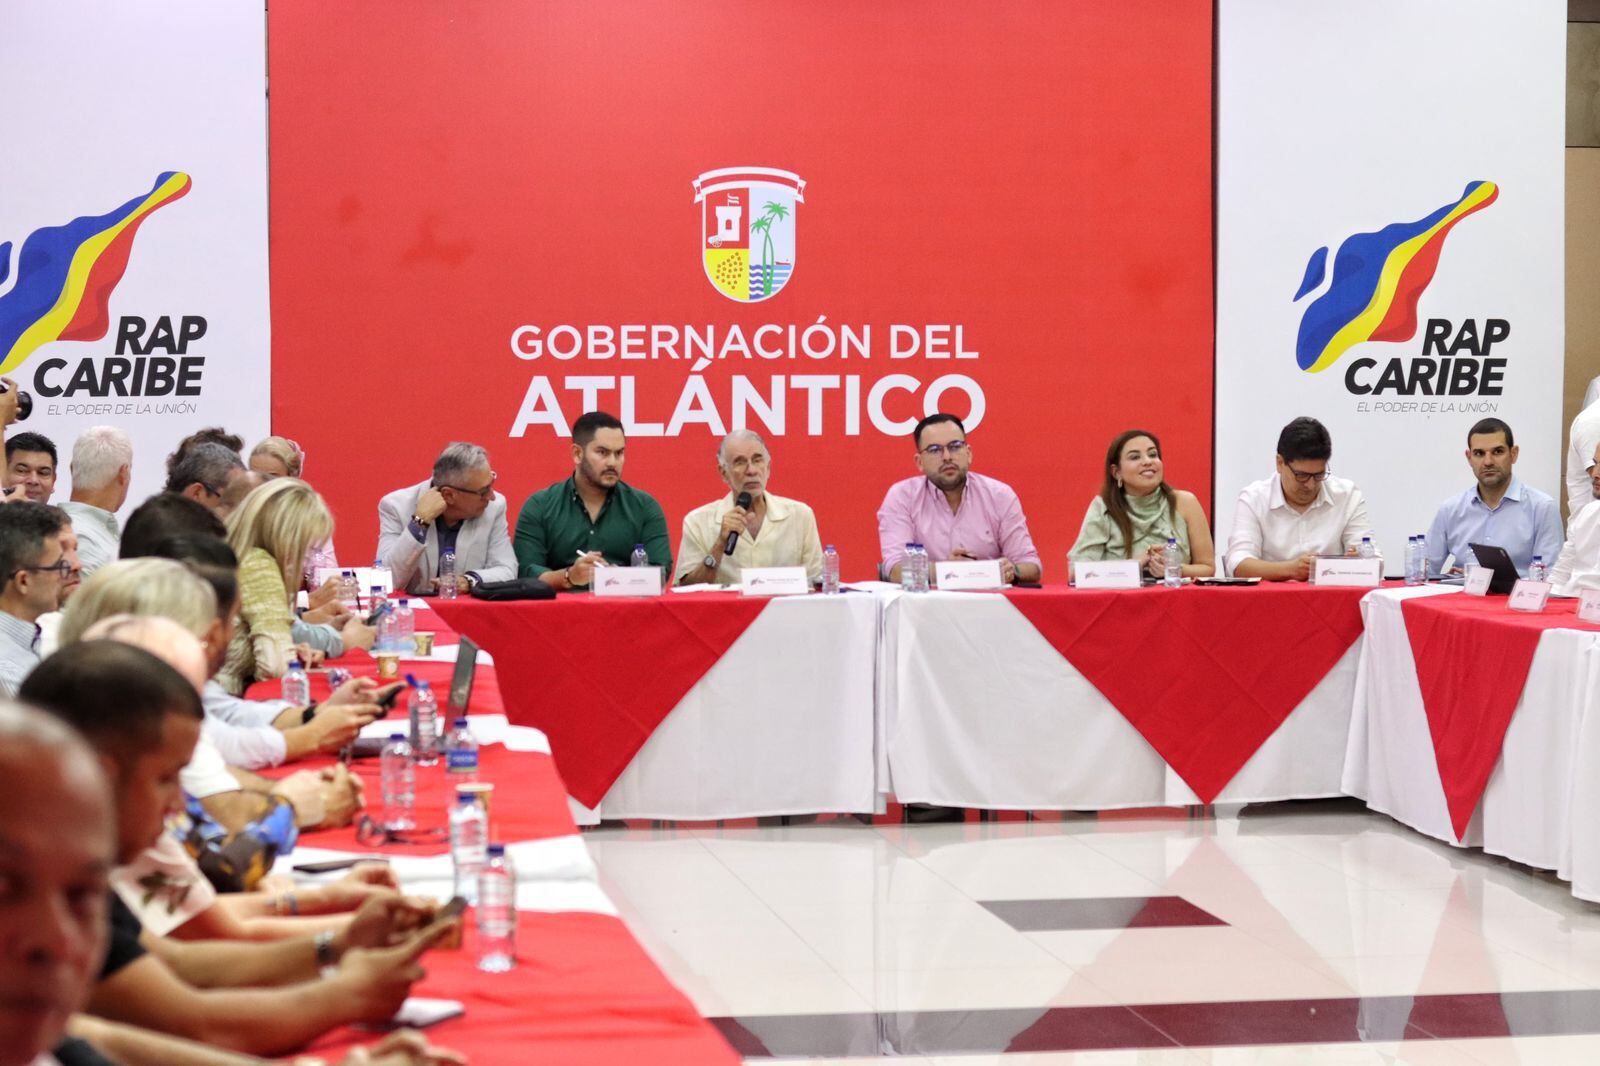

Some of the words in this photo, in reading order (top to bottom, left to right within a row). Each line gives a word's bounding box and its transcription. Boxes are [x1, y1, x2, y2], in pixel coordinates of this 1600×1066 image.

[115, 315, 208, 356] RAP
[510, 314, 871, 360] GOBERNACIÓN
[889, 324, 979, 359] DEL
[1421, 318, 1511, 357] RAP
[33, 356, 206, 398] CARIBE
[1344, 357, 1508, 396] CARIBE
[47, 404, 62, 416] EL
[65, 403, 112, 416] PODER
[114, 403, 134, 415] DE
[135, 403, 151, 415] LA
[155, 400, 197, 415] UNIÓN
[508, 356, 987, 438] ATLÁNTICO
[1356, 401, 1371, 413] EL
[1374, 401, 1418, 413] PODER
[1420, 401, 1439, 413] DE
[1440, 401, 1456, 413] LA
[1458, 399, 1499, 413] UNIÓN
